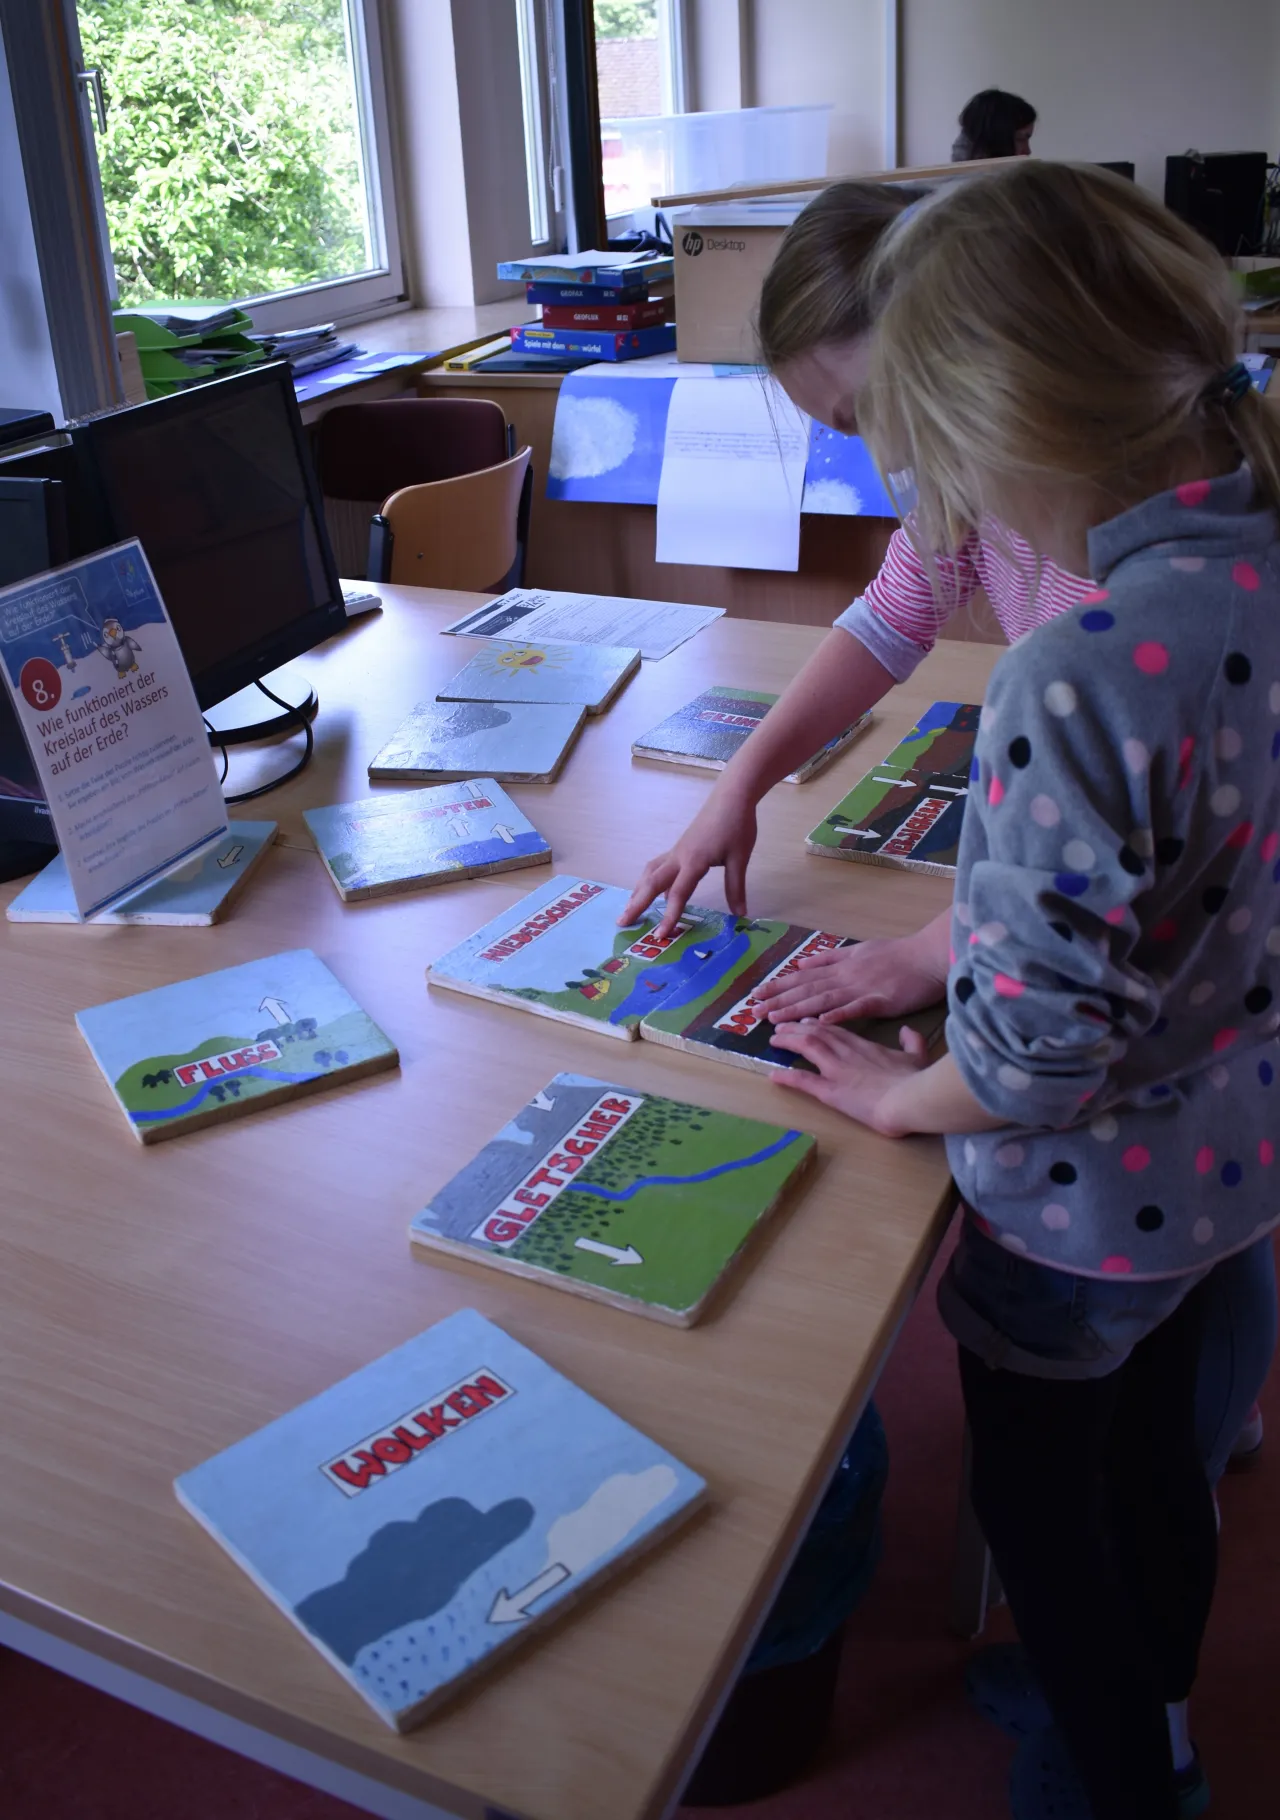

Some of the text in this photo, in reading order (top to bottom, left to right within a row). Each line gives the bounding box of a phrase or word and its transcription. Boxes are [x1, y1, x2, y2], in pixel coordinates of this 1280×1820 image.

[684, 231, 702, 257] hp
[707, 238, 746, 253] Desktop
[573, 313, 599, 321] GEOFLUX
[524, 339, 541, 350] Spiele
[542, 341, 552, 349] mit
[32, 679, 55, 704] 8.
[37, 672, 157, 738] Wie funktioniert der
[43, 685, 169, 757] Kreislauf des Wassers
[50, 722, 129, 776] auf der Erde?
[882, 798, 949, 856] VERSICKERN
[479, 884, 605, 964] NIEDERSCHLAG
[176, 1043, 279, 1085] FLUSS
[483, 1097, 632, 1242] GLETSCHER
[329, 1375, 509, 1489] WOLKEN
